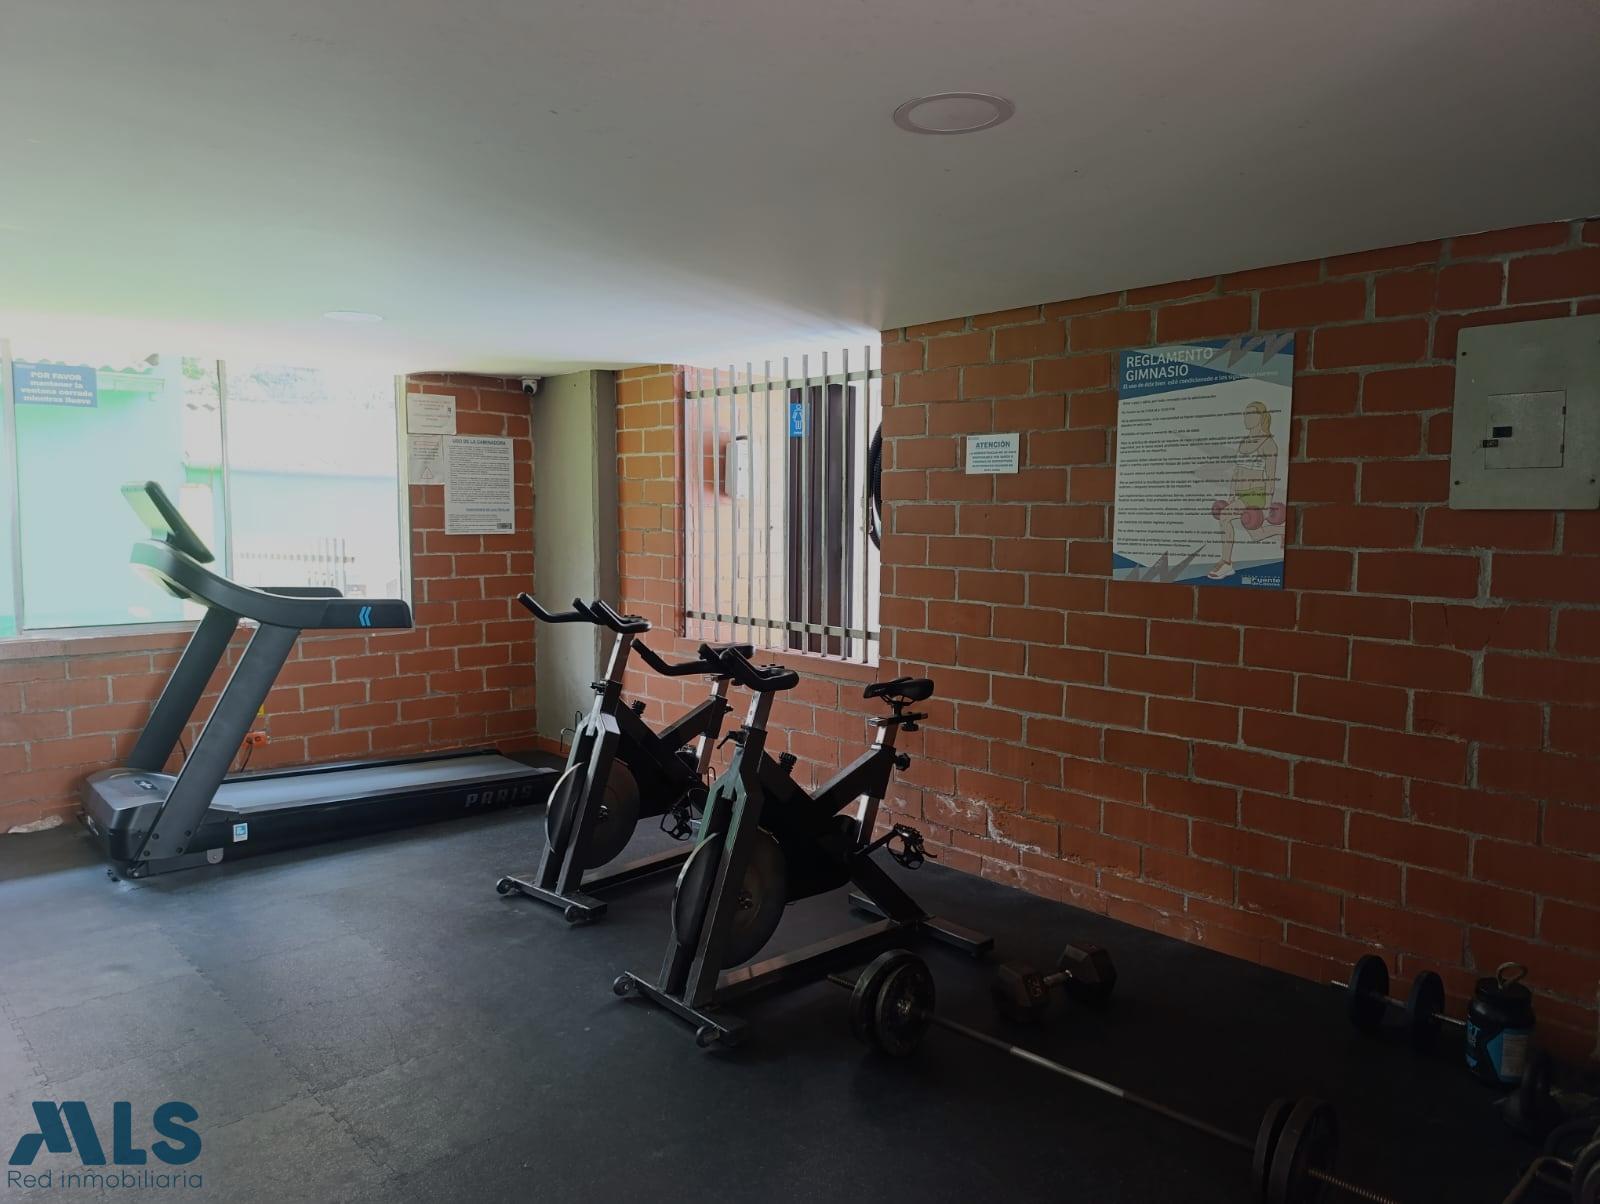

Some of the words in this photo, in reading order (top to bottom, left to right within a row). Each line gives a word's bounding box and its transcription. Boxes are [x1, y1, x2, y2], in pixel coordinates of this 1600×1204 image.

[1126, 347, 1213, 369] REGLAMENTO
[31, 371, 50, 380] POR
[52, 373, 82, 382] FAVOR
[1125, 364, 1189, 382] GIMNASIO
[465, 784, 533, 807] PARIS
